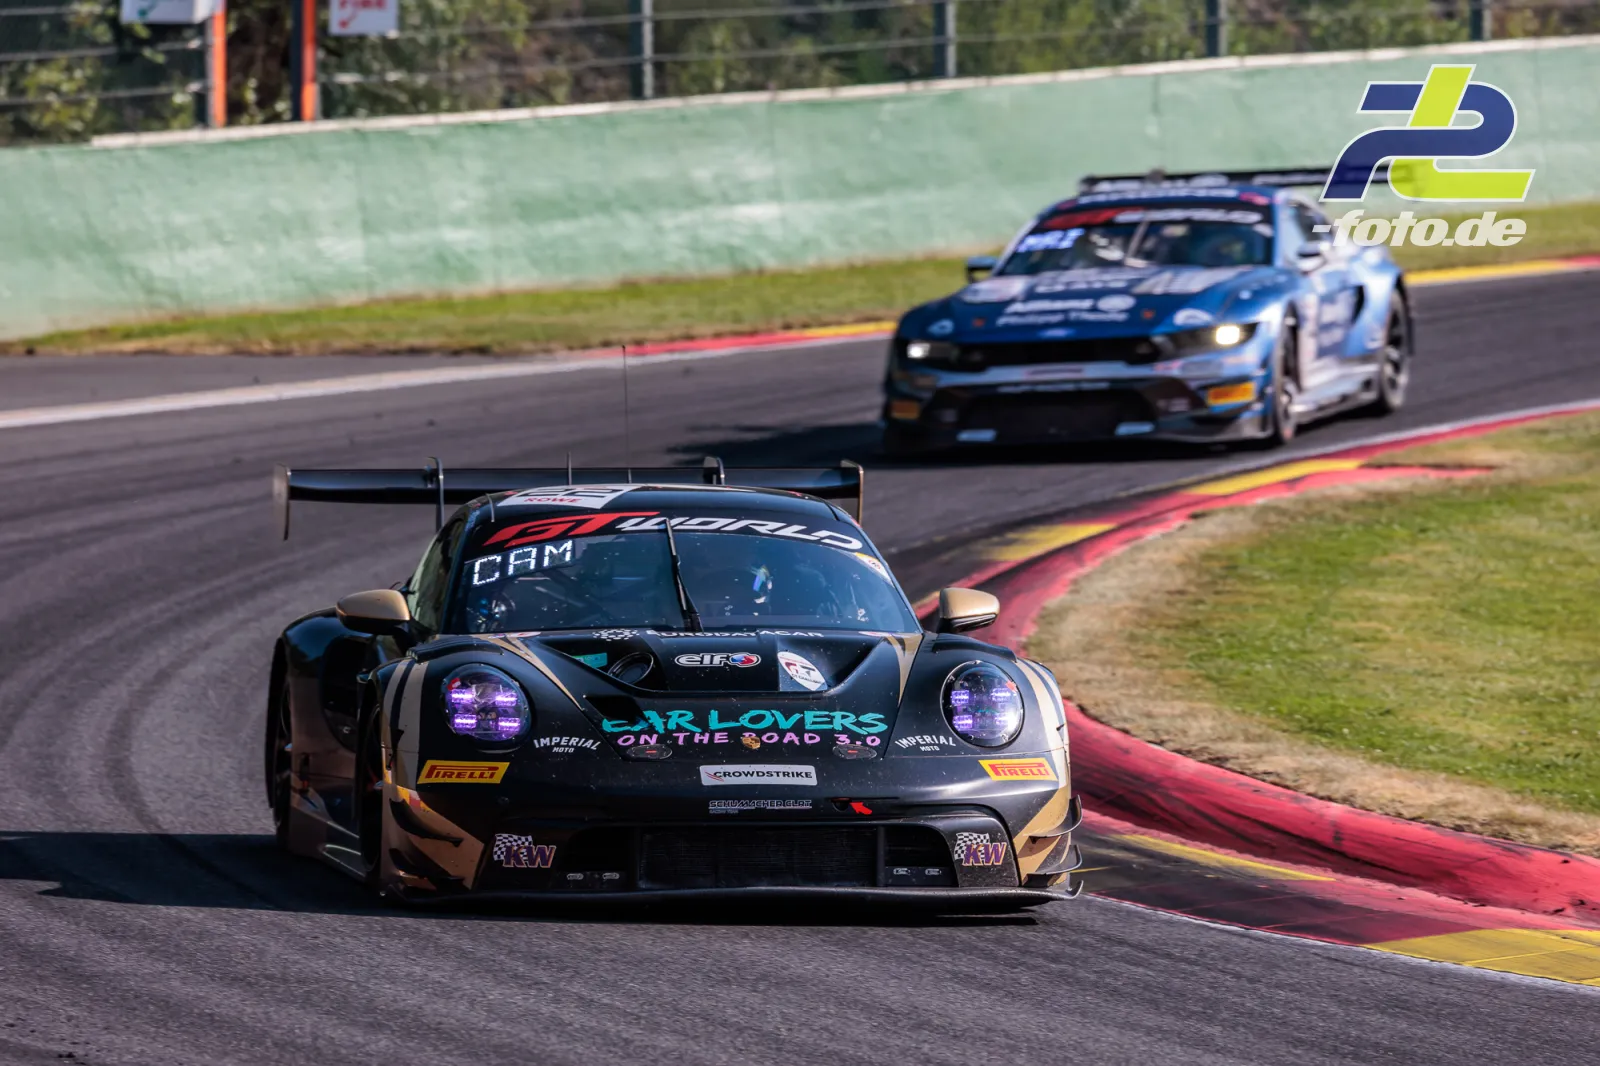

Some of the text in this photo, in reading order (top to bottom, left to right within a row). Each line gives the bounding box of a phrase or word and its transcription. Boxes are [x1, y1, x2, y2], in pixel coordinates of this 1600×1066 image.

[473, 540, 574, 587] CAM
[708, 710, 888, 735] LOVERS
[533, 736, 601, 750] IMPERIAL
[617, 733, 659, 746] ON
[672, 732, 730, 745] THE
[834, 733, 881, 747] 3.0
[895, 734, 957, 749] IMPERIAL
[425, 763, 500, 779] PIRELLI
[713, 770, 813, 780] CROWDSTRIKE
[988, 762, 1050, 777] PIRELLI
[503, 844, 556, 868] KW
[963, 842, 1007, 866] KW
